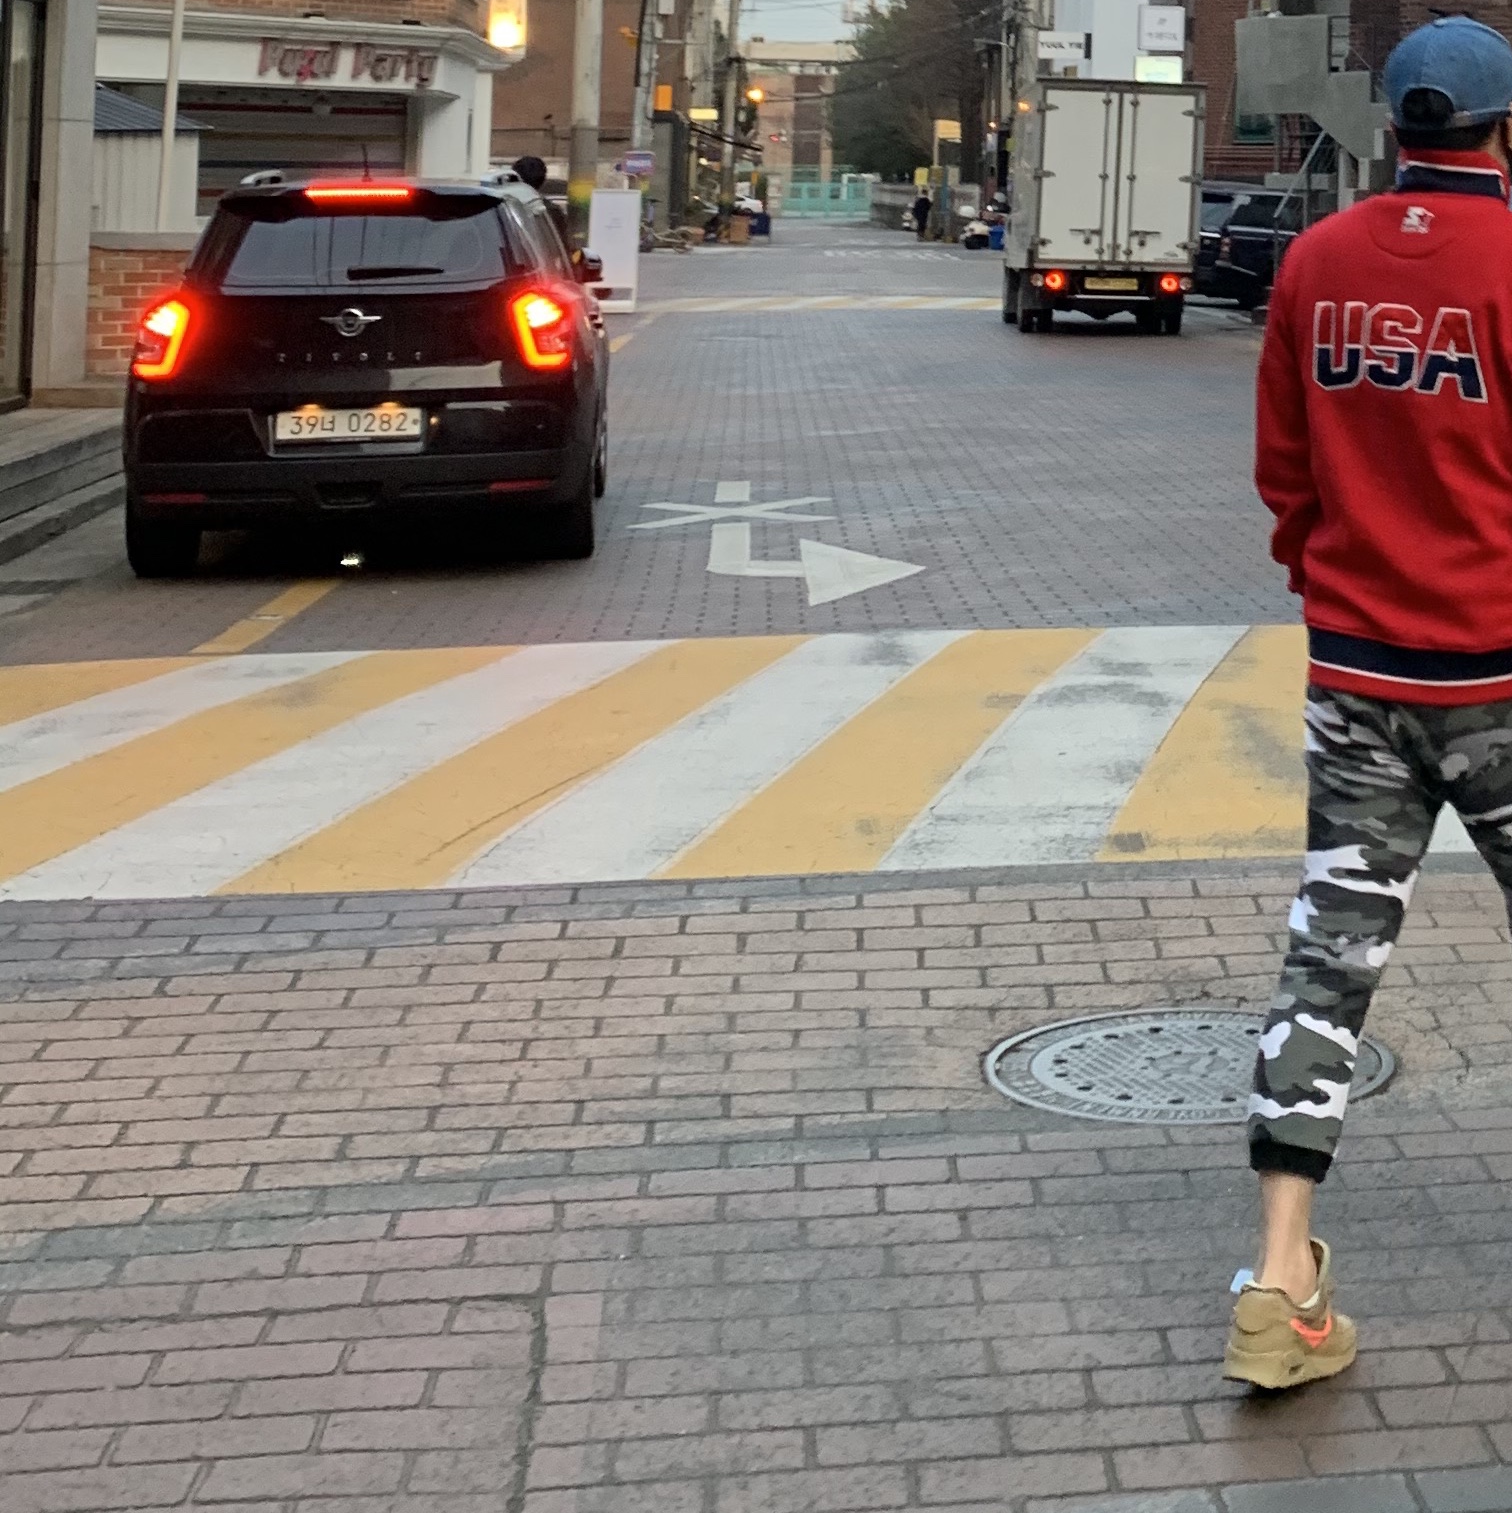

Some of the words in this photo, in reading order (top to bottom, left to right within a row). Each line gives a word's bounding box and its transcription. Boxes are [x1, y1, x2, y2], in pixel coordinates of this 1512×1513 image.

[1312, 300, 1489, 404] USA
[289, 415, 336, 435] 39너
[347, 411, 408, 433] 0282
